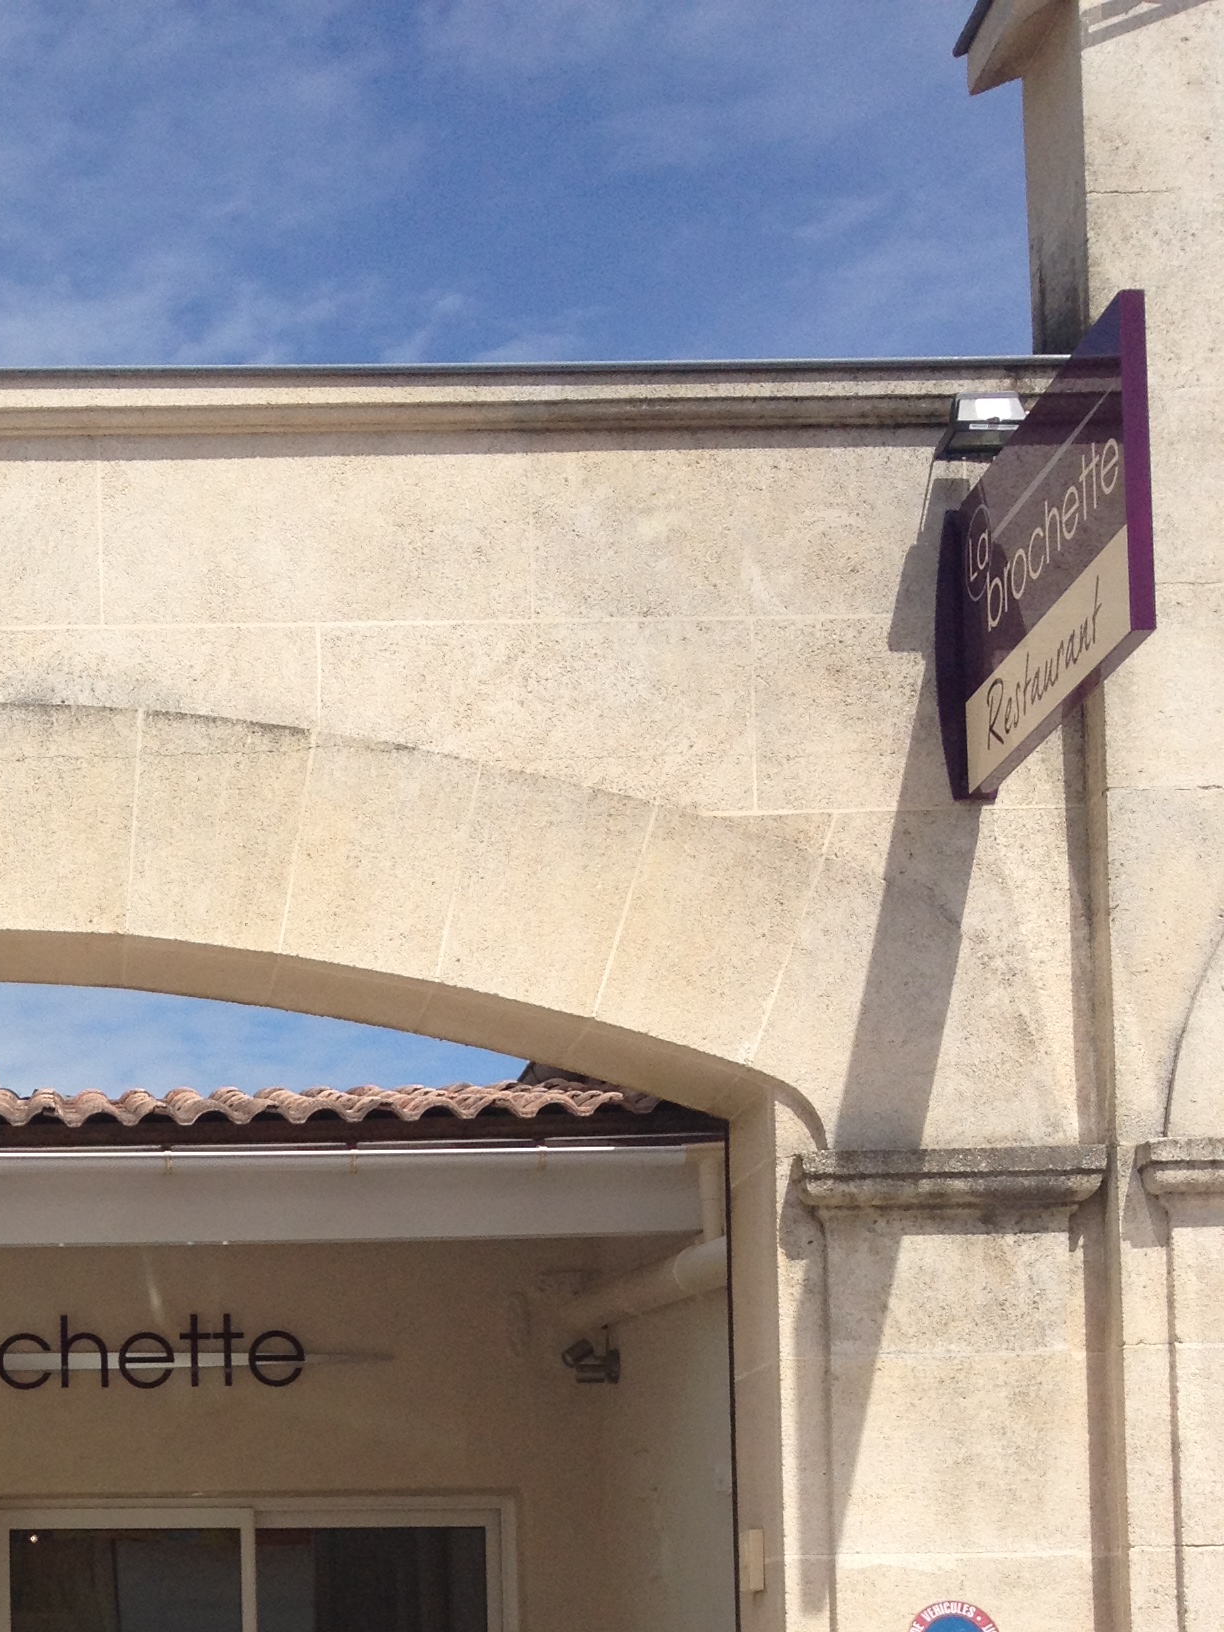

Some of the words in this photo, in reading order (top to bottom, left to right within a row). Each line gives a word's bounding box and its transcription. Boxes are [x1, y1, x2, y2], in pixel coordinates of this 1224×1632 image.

[969, 529, 989, 582] La
[986, 438, 1119, 632] brochette
[986, 575, 1102, 750] Restaurant
